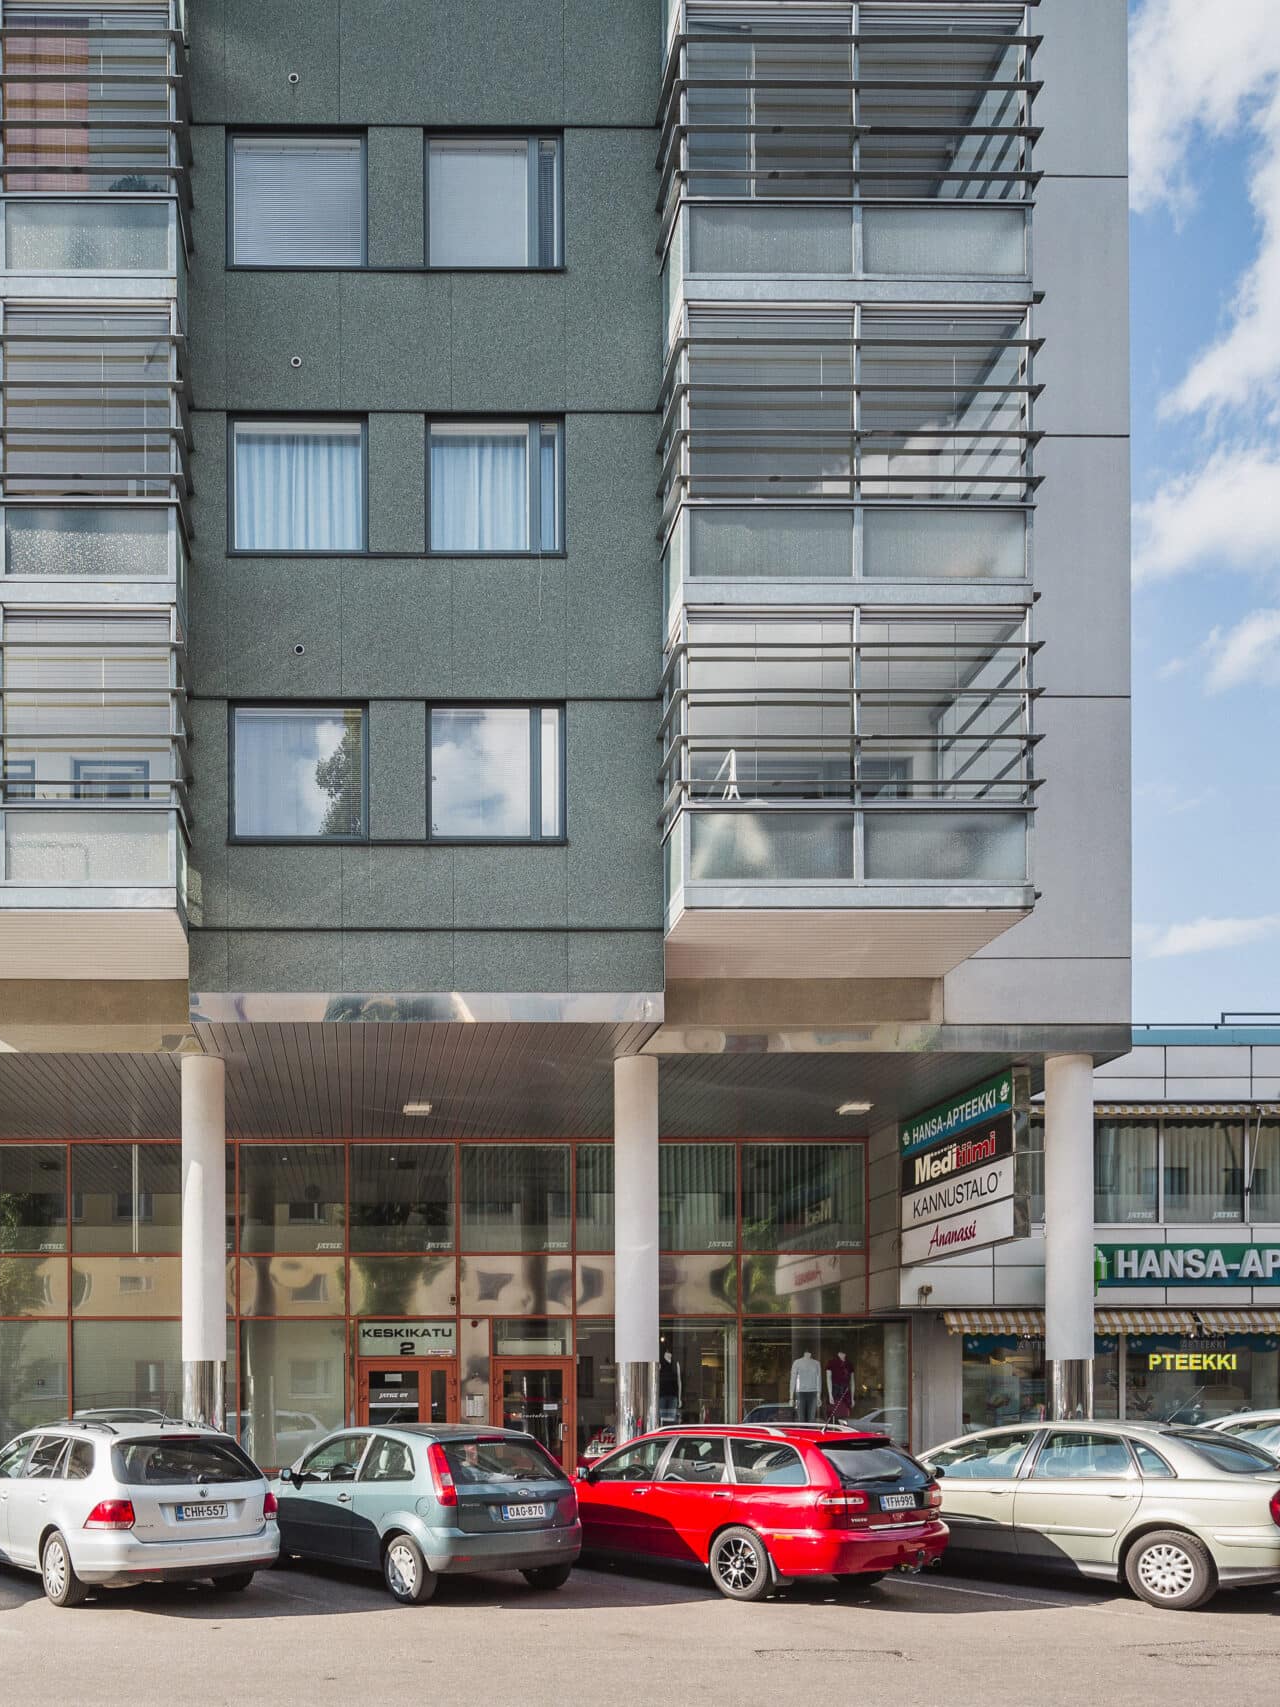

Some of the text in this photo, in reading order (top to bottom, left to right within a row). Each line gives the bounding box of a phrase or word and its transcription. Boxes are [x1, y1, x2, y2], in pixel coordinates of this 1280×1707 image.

[912, 1088, 996, 1144] HANSA-APTEEKKI
[914, 1130, 996, 1185] Meditiimi
[927, 1220, 977, 1256] Ananassi
[362, 1328, 452, 1338] KESKIKATU
[400, 1342, 415, 1355] 2
[1148, 1353, 1237, 1371] PTEEKKI
[184, 1505, 225, 1518] CHH-557
[509, 1505, 544, 1517] OAG-870
